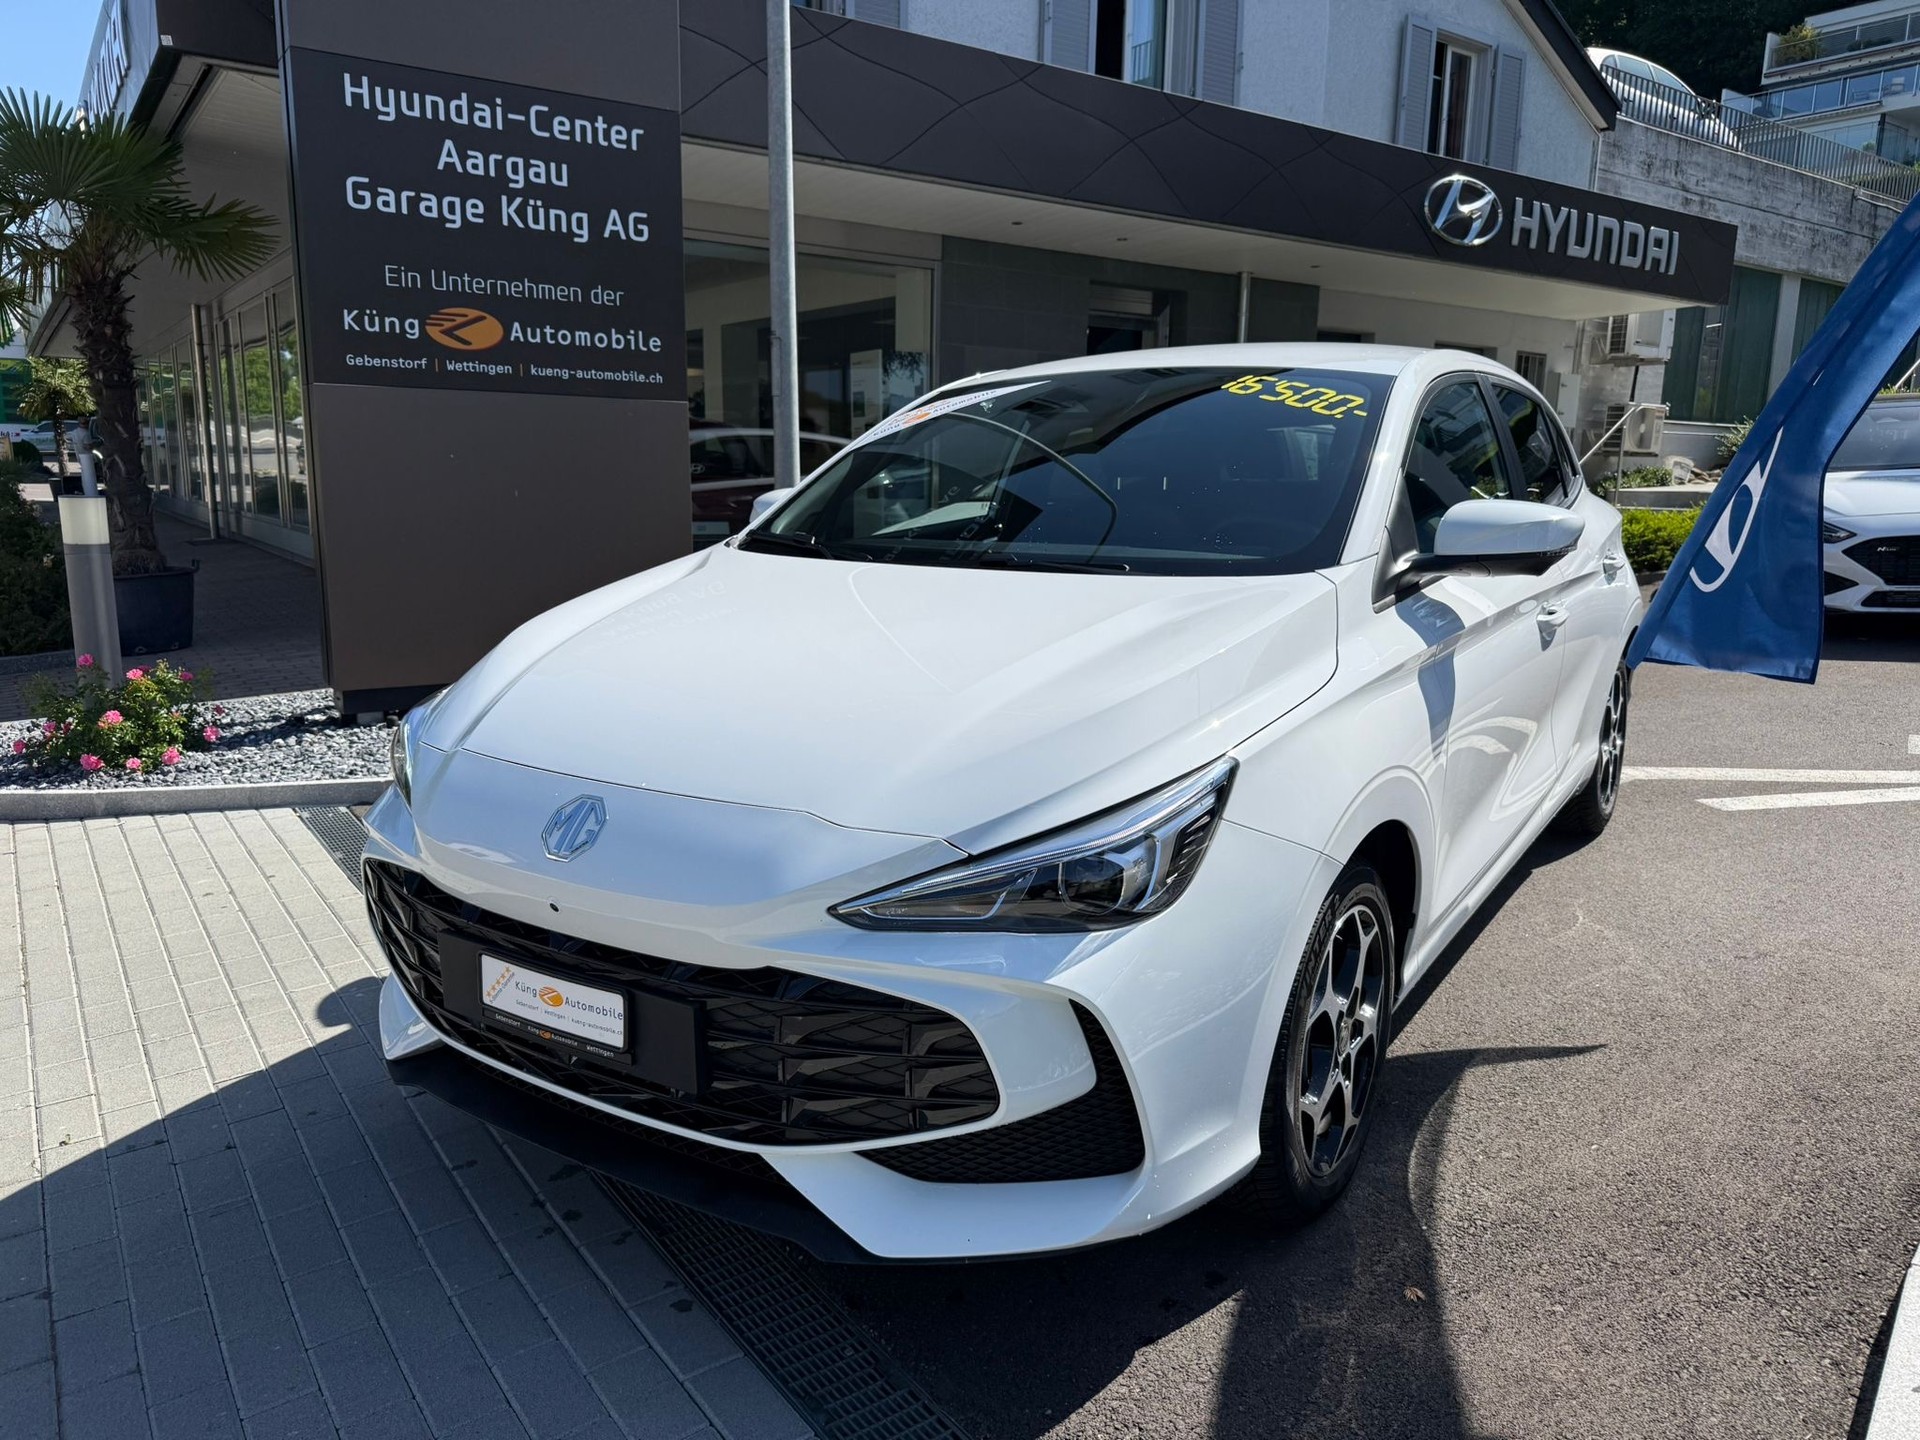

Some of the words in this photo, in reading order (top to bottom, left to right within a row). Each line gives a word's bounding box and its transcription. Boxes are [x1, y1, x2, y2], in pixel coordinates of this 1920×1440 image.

[343, 72, 644, 151] Hyundai-Center
[437, 138, 568, 189] Aargau
[345, 176, 485, 229] Garage
[501, 194, 589, 243] Küng
[603, 208, 650, 242] AG
[1510, 196, 1680, 276] HYUNDAI
[385, 264, 421, 289] Ein
[431, 269, 582, 303] Unternehmen
[590, 285, 624, 306] der
[343, 309, 420, 339] Küng
[510, 321, 662, 352] Automobile
[346, 353, 427, 369] Gebenstorf
[446, 359, 512, 376] Wettingen
[530, 364, 663, 384] kueng-automobile.ch
[542, 796, 606, 861] MG
[515, 981, 538, 998] Küng
[564, 996, 623, 1021] Automobile
